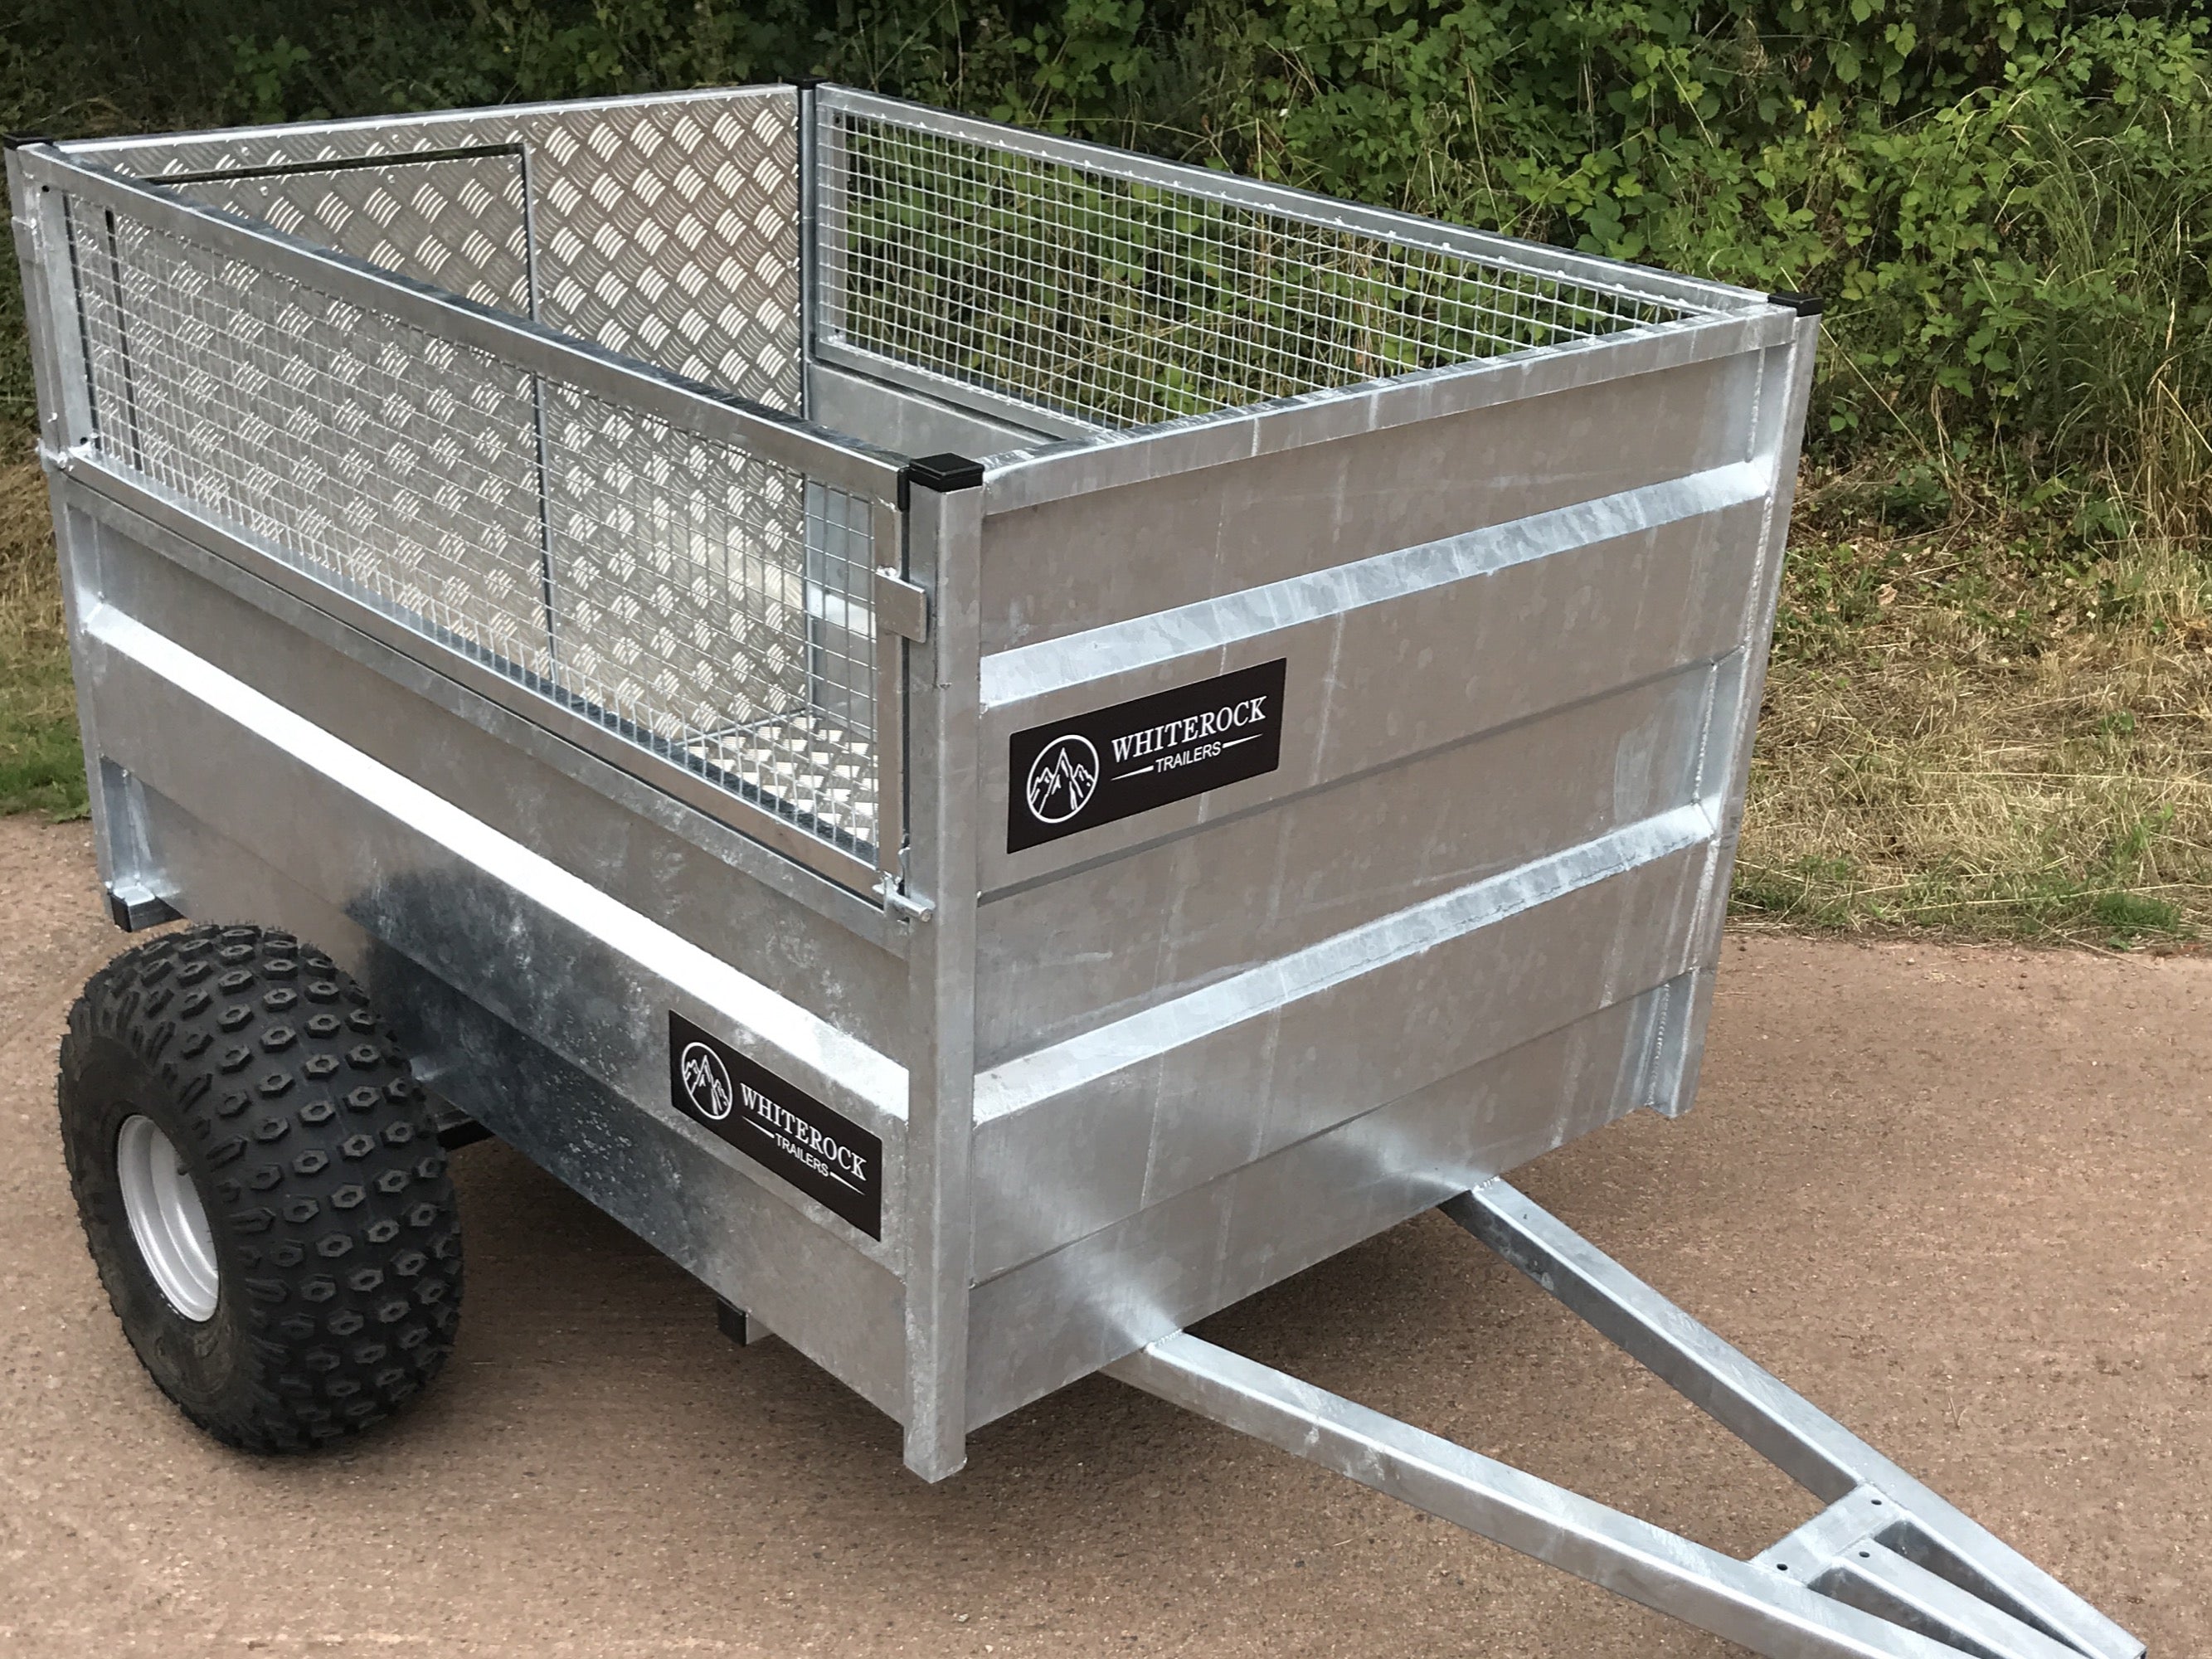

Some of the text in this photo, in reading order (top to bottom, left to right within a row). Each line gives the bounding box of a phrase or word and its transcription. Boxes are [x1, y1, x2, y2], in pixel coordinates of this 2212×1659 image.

[1111, 695, 1267, 763] WHITEROCK
[1155, 741, 1222, 773] TRAILERS
[740, 1082, 868, 1181] WHITEROCK
[775, 1133, 829, 1177] TRAILERS
